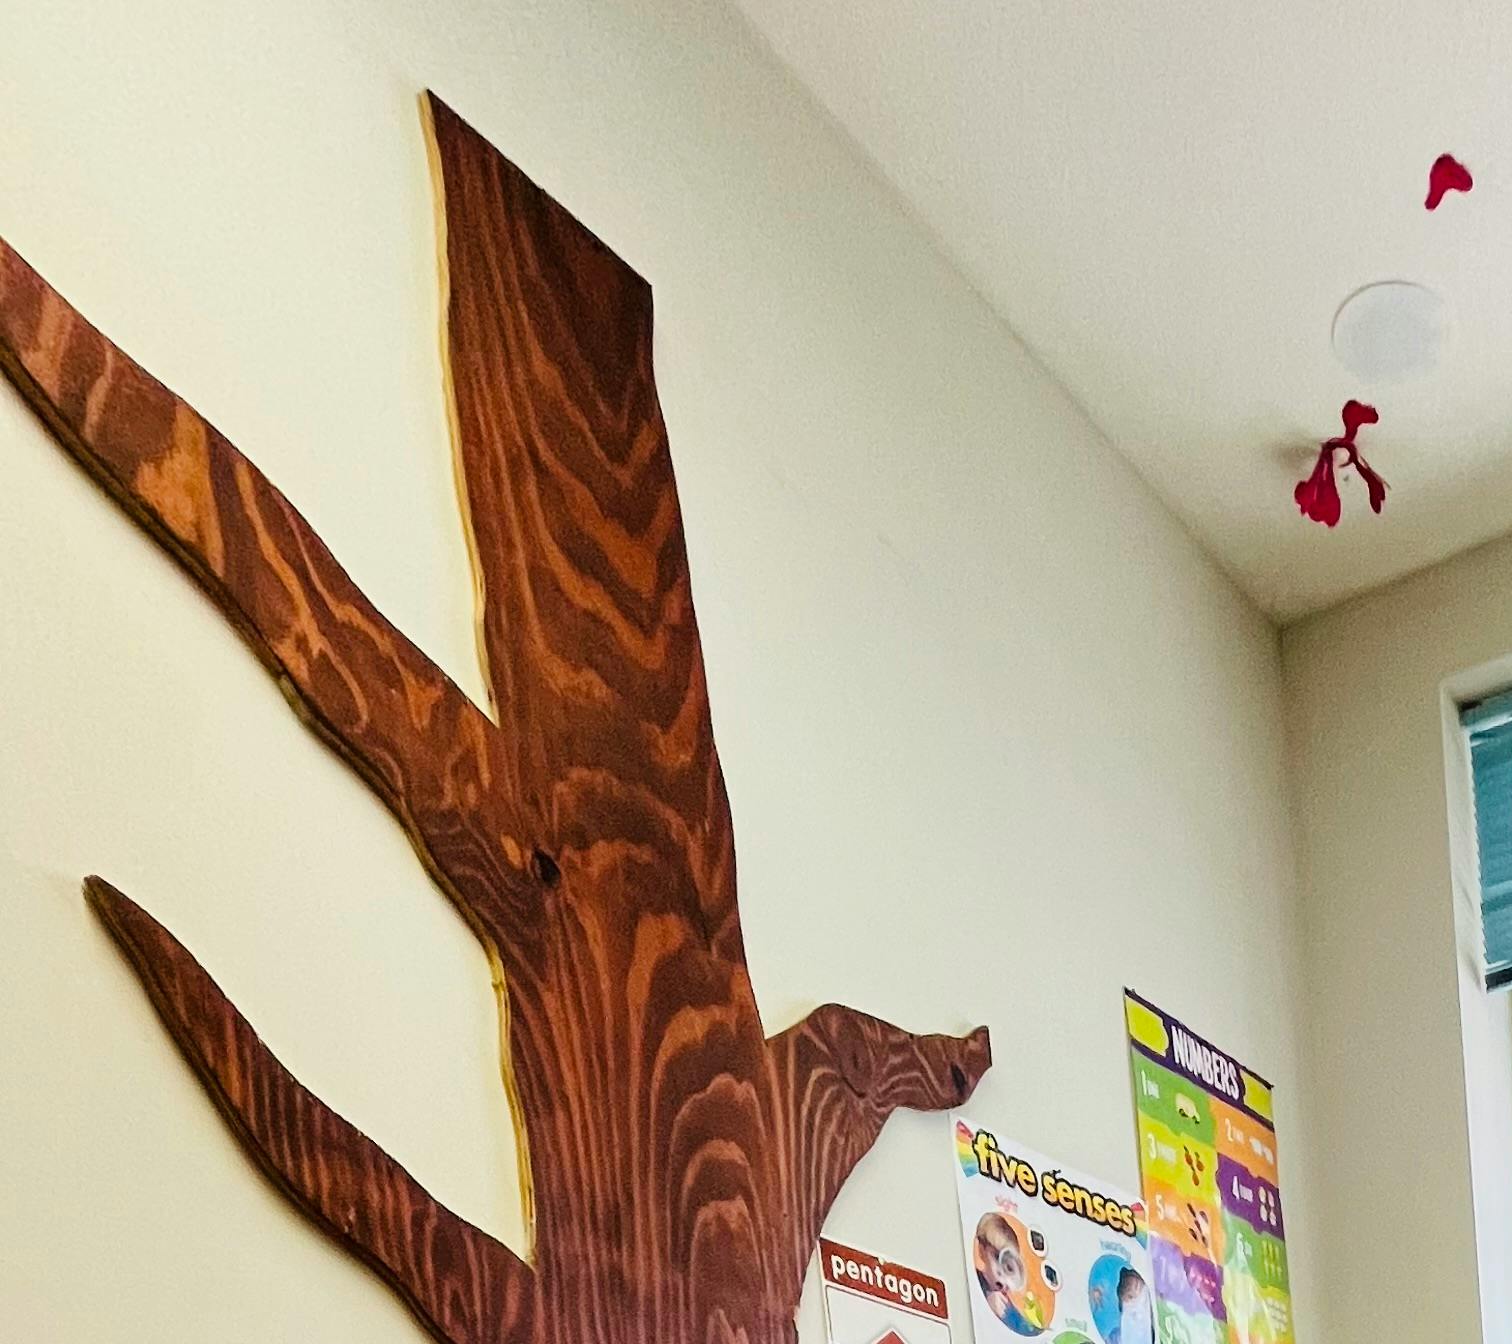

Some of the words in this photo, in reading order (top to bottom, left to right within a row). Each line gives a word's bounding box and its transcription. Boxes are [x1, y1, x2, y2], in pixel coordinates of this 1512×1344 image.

[1172, 1026, 1240, 1102] NUMBERS
[973, 1130, 1038, 1198] five
[1041, 1168, 1136, 1237] senses
[829, 1253, 941, 1309] pentagon
